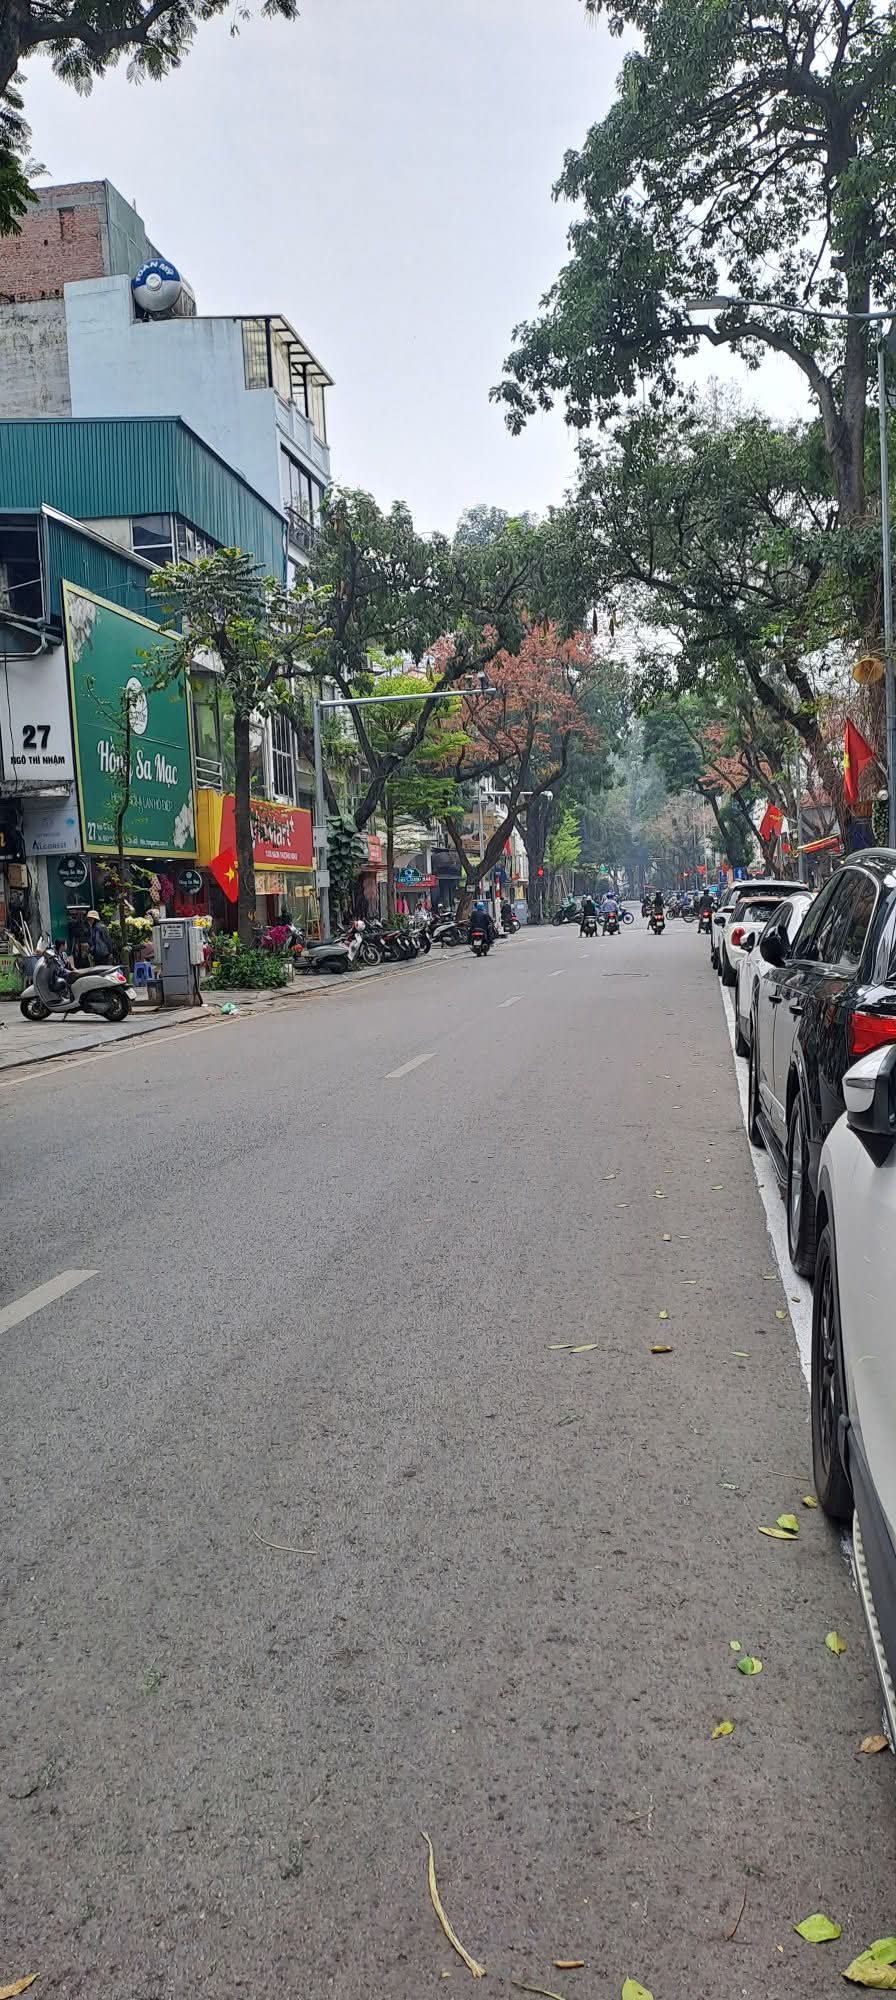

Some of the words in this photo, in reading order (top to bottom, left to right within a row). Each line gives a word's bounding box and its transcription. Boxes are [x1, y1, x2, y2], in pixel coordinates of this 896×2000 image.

[22, 725, 51, 749] 27
[11, 755, 26, 765] NGÔ
[29, 754, 41, 765] THÌ
[43, 755, 65, 766] NHẬM
[136, 749, 152, 781] Sa
[154, 753, 178, 788] Mạc
[87, 822, 96, 841] 27
